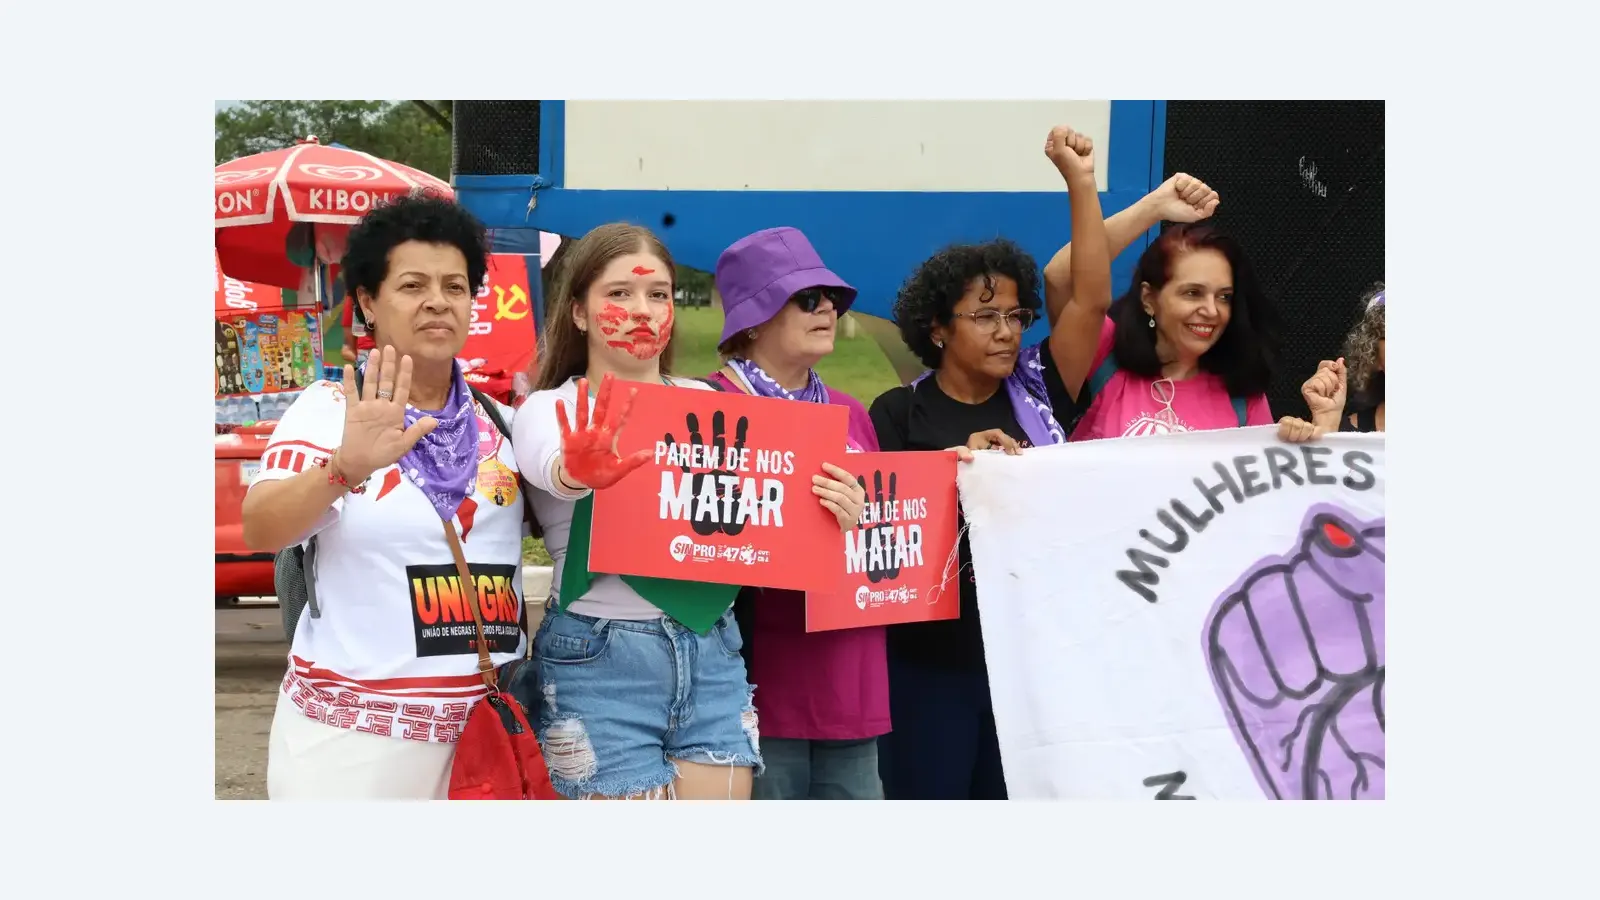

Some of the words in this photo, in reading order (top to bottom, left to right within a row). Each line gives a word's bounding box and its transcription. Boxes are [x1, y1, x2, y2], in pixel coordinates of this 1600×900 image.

[655, 440, 720, 469] PAREM
[726, 446, 750, 471] DE
[756, 449, 795, 475] NOS
[658, 470, 784, 527] MATAR
[885, 499, 900, 521] DE
[903, 496, 928, 521] NOS
[1115, 446, 1376, 604] MULHERES
[844, 523, 924, 574] MATAR
[422, 625, 440, 639] UNIÃO
[442, 626, 450, 637] DE
[450, 625, 472, 636] NEGRAS
